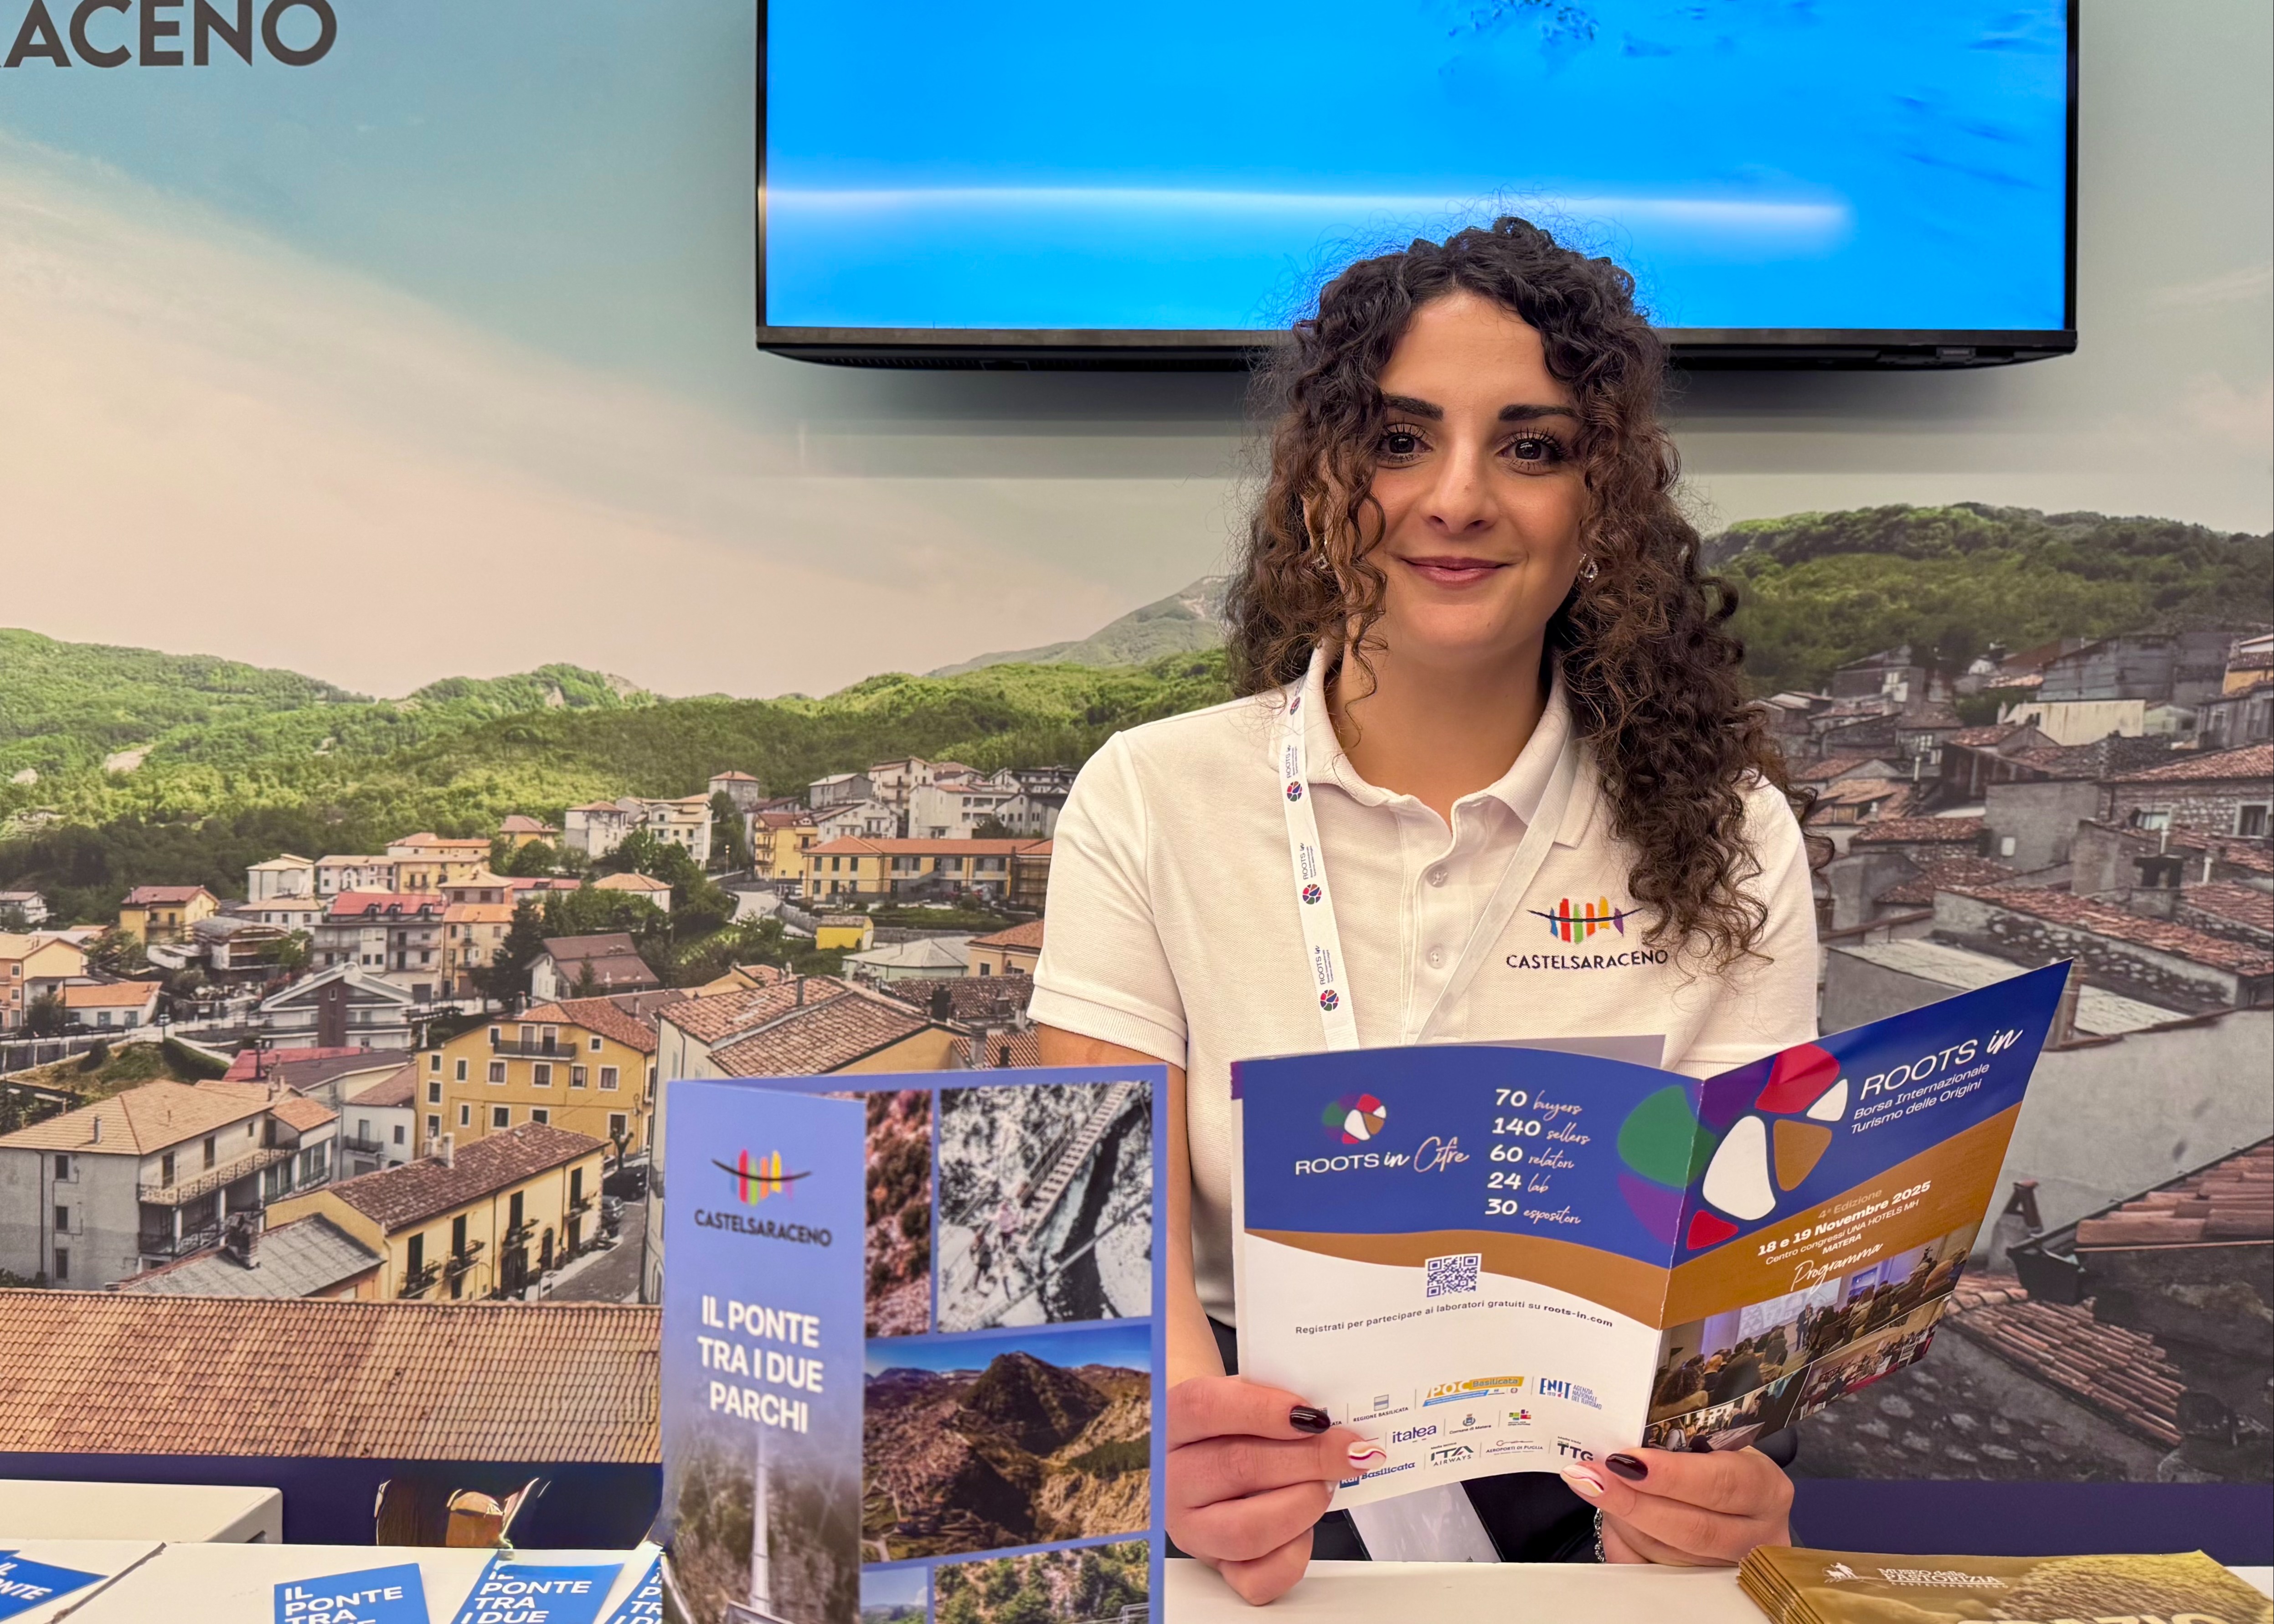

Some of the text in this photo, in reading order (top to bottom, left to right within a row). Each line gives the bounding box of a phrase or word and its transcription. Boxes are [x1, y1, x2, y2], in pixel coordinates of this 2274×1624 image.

[0, 0, 337, 68] ACENO
[1300, 853, 1309, 880] ROOTS
[1315, 956, 1326, 985] ROOTS
[1506, 949, 1669, 970] CASTELSARACENO
[1860, 1029, 2023, 1101] ROOTS in
[1853, 1063, 1990, 1120] Borsa Internazionale
[1495, 1088, 1583, 1121] 70 buyers
[1851, 1078, 1982, 1134] Turismo delle Origini
[1492, 1117, 1590, 1145] 140 sellers
[1295, 1136, 1470, 1175] ROOTS in Cifre
[1490, 1144, 1523, 1162] 60
[1487, 1172, 1551, 1193] 24 lab
[1485, 1198, 1581, 1224] 30 espositori
[1833, 1189, 1882, 1215] Edizione
[694, 1209, 832, 1247] CASTELSARACENO
[1758, 1181, 1932, 1256] 18 e 19 Novembre 2025
[1766, 1199, 1919, 1265] Centro congressi UNA HOTELS MH
[1822, 1233, 1862, 1255] MATERA
[1790, 1242, 1883, 1295] Programma
[701, 1295, 820, 1349] IL PONTE
[1295, 1322, 1344, 1335] Registrati
[1347, 1320, 1363, 1330] per
[1366, 1310, 1422, 1327] partecipare
[1425, 1306, 1433, 1315] ai
[1436, 1300, 1484, 1312] laboratori
[1543, 1305, 1613, 1327] roots-in.com
[696, 1335, 824, 1393] TRA I DUE
[1430, 1378, 1518, 1397] POC Basilicata
[1539, 1377, 1572, 1399] ENIT
[1573, 1390, 1597, 1402] NAZIONALE
[710, 1381, 808, 1434] PARCHI
[1353, 1407, 1408, 1422] REGIONE BASILICATA
[1581, 1397, 1602, 1410] TURISMO
[1392, 1424, 1437, 1444] italea
[1431, 1445, 1474, 1461] ITA
[1433, 1454, 1471, 1467] AIRWAYS
[1557, 1443, 1593, 1461] TTG
[1361, 1462, 1415, 1480] Basilicata
[0, 1578, 53, 1600] NTE
[480, 1581, 592, 1595] PONTE
[1882, 1573, 2002, 1583] PASTORIZIA
[285, 1586, 314, 1601] IL
[285, 1586, 403, 1617] PONTE
[474, 1596, 536, 1609] TRA
[284, 1609, 357, 1624] TRA
[460, 1610, 549, 1624] I DUE
[630, 1601, 662, 1614] TR
